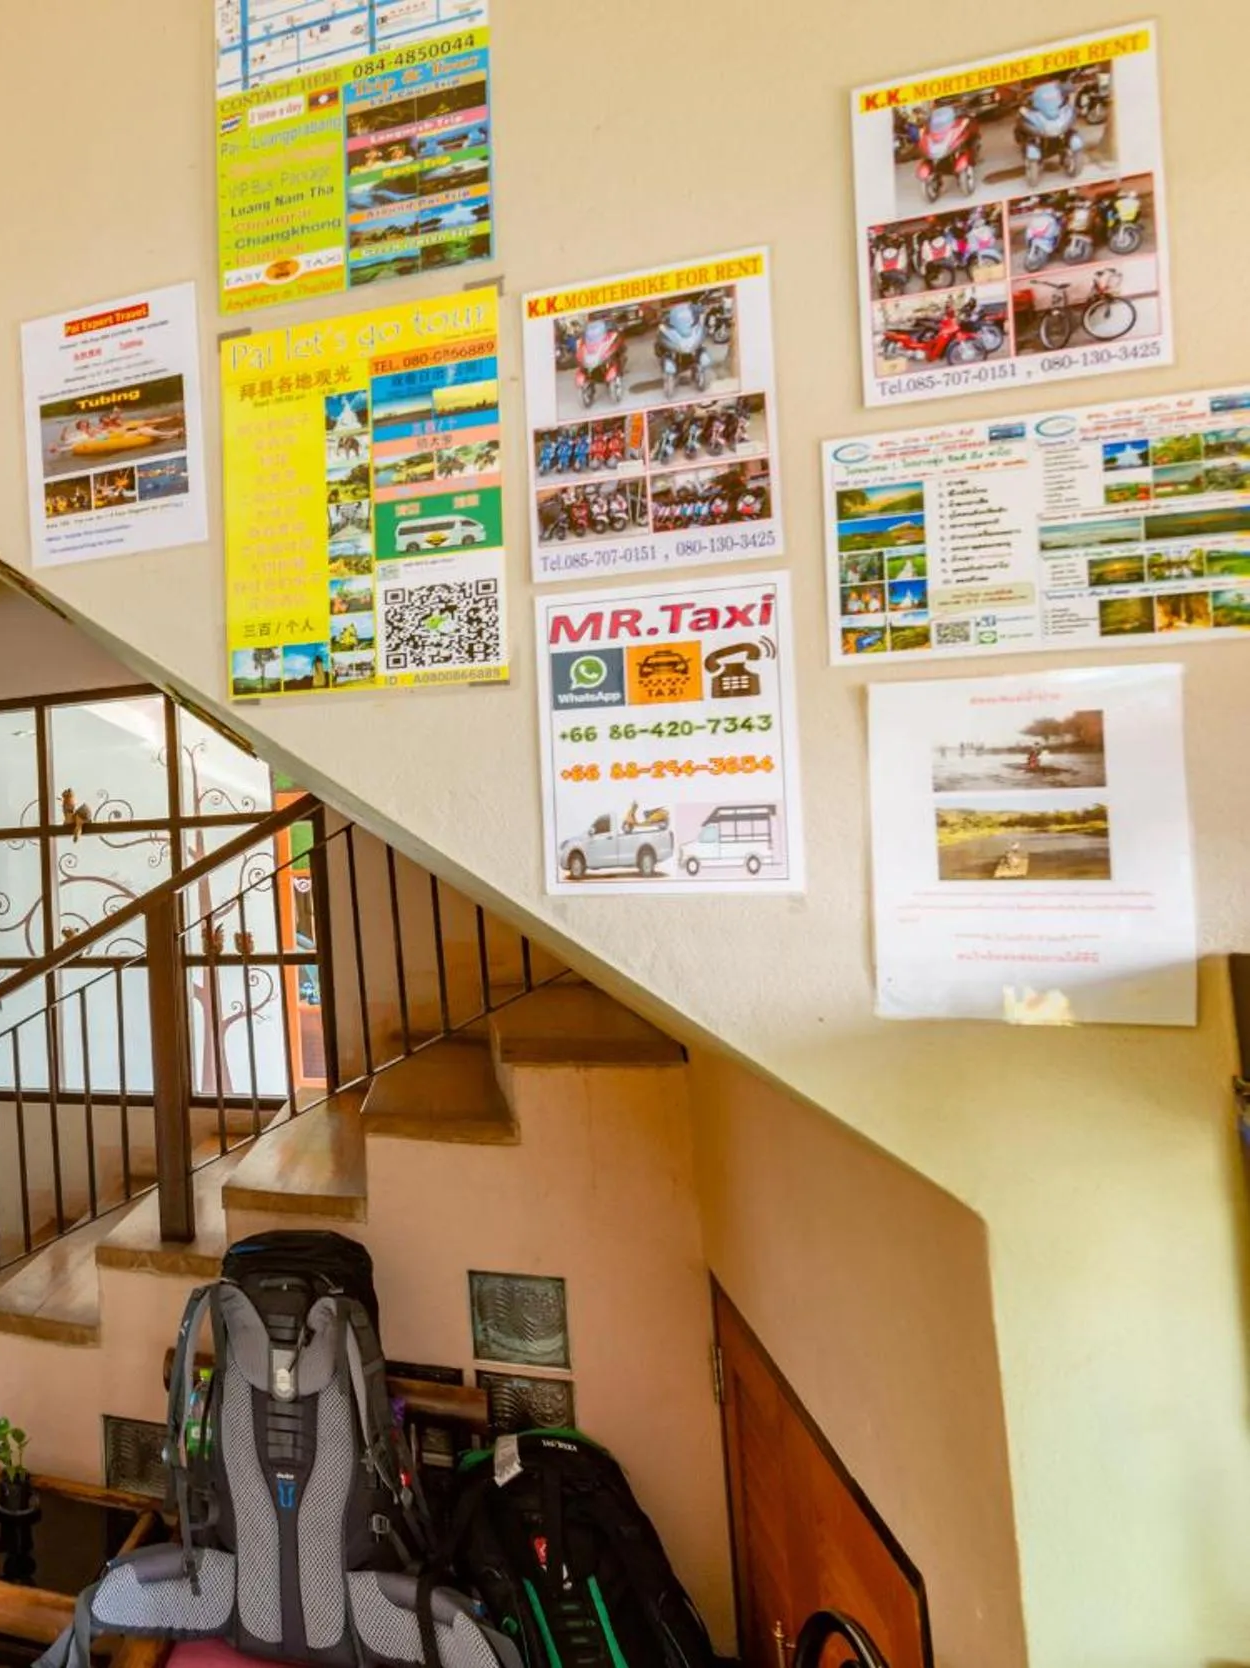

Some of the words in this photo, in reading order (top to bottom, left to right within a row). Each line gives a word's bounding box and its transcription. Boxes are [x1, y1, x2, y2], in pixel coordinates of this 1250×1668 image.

[352, 34, 476, 79] 084-4850044
[913, 62, 1032, 99] MORTERBIKE
[1042, 49, 1081, 72] FOR
[1088, 35, 1140, 60] RENT
[220, 82, 293, 112] CONTACT
[300, 68, 343, 91] HERE
[230, 198, 271, 219] Luang
[235, 217, 342, 249] Chiangkhong
[676, 267, 710, 288] FOR
[715, 257, 762, 281] RENT
[232, 342, 273, 371] Pai
[286, 326, 347, 359] let's
[358, 320, 400, 357] go
[414, 304, 487, 336] tour
[1041, 341, 1161, 373] 080-130-3425
[76, 388, 141, 410] Tubing
[676, 530, 776, 558] 080-130-3425
[549, 593, 776, 645] MR.Taxi
[557, 691, 621, 705] WhatsApp
[559, 726, 598, 743] +66
[609, 714, 772, 741] 86-420-7343
